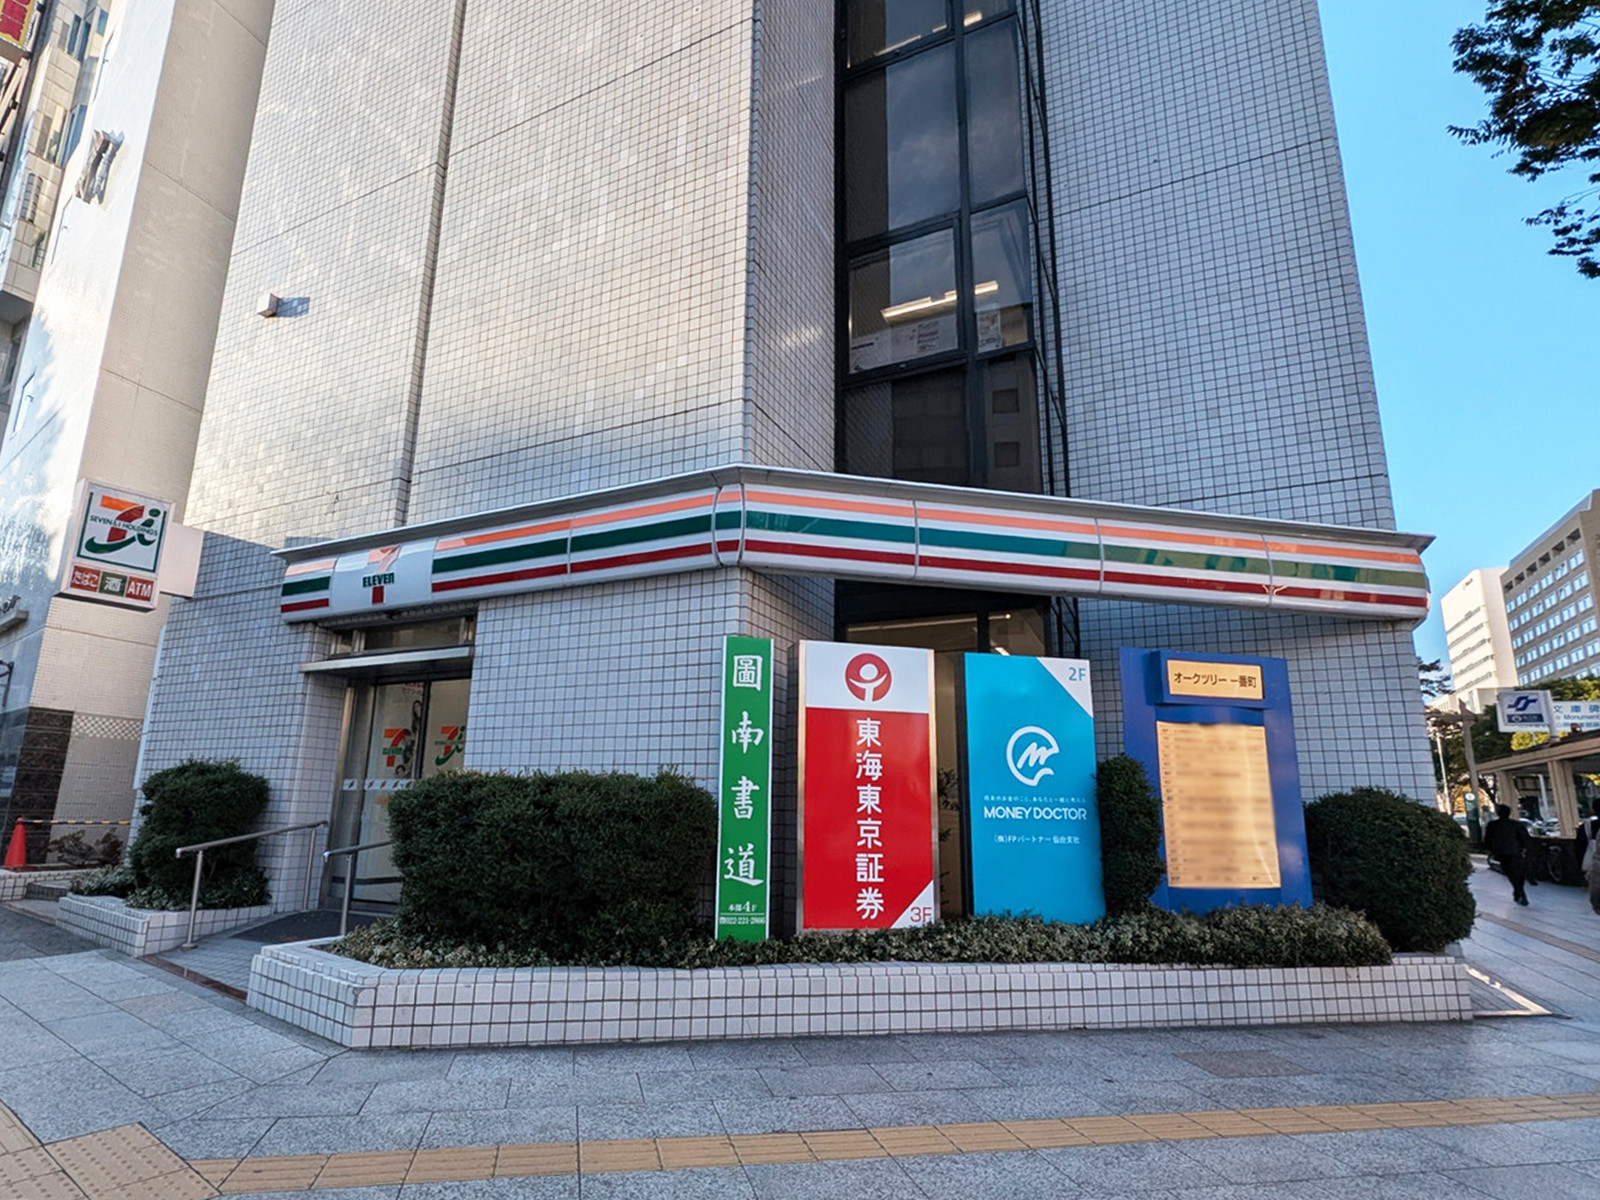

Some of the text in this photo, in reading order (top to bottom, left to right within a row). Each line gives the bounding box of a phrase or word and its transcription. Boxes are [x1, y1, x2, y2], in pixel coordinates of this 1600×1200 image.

[71, 570, 98, 588] たばこ
[104, 576, 122, 592] 酒
[127, 580, 152, 597] ATM
[1068, 667, 1086, 681] 2F
[724, 654, 764, 886] 圖南書道
[855, 717, 885, 919] 東海東京証券
[984, 806, 1087, 820] MONEY DOCTOR
[910, 906, 932, 923] 3F
